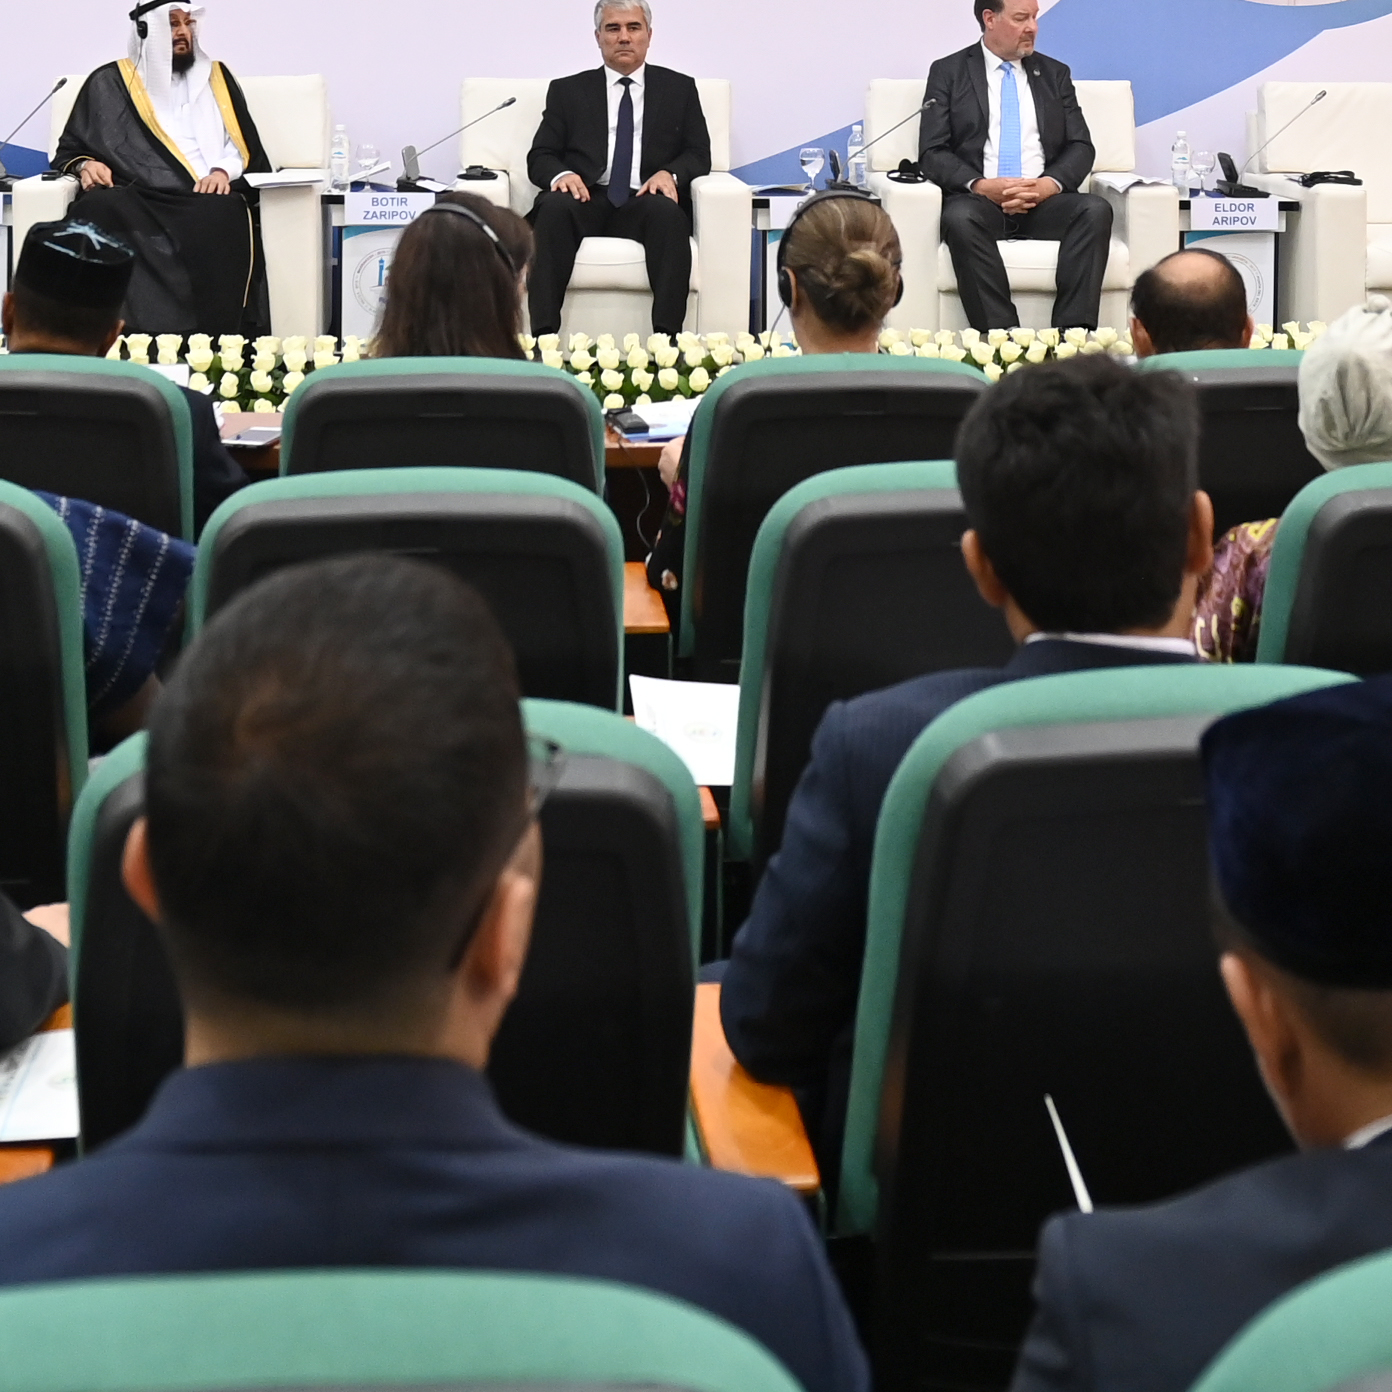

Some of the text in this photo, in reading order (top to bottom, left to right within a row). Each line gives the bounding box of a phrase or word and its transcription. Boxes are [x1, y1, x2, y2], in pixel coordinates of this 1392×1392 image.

[371, 197, 408, 206] BOTIR
[1215, 203, 1255, 212] ELDOR
[363, 211, 416, 220] ZARIPOV
[1212, 216, 1257, 225] ARIPOV
